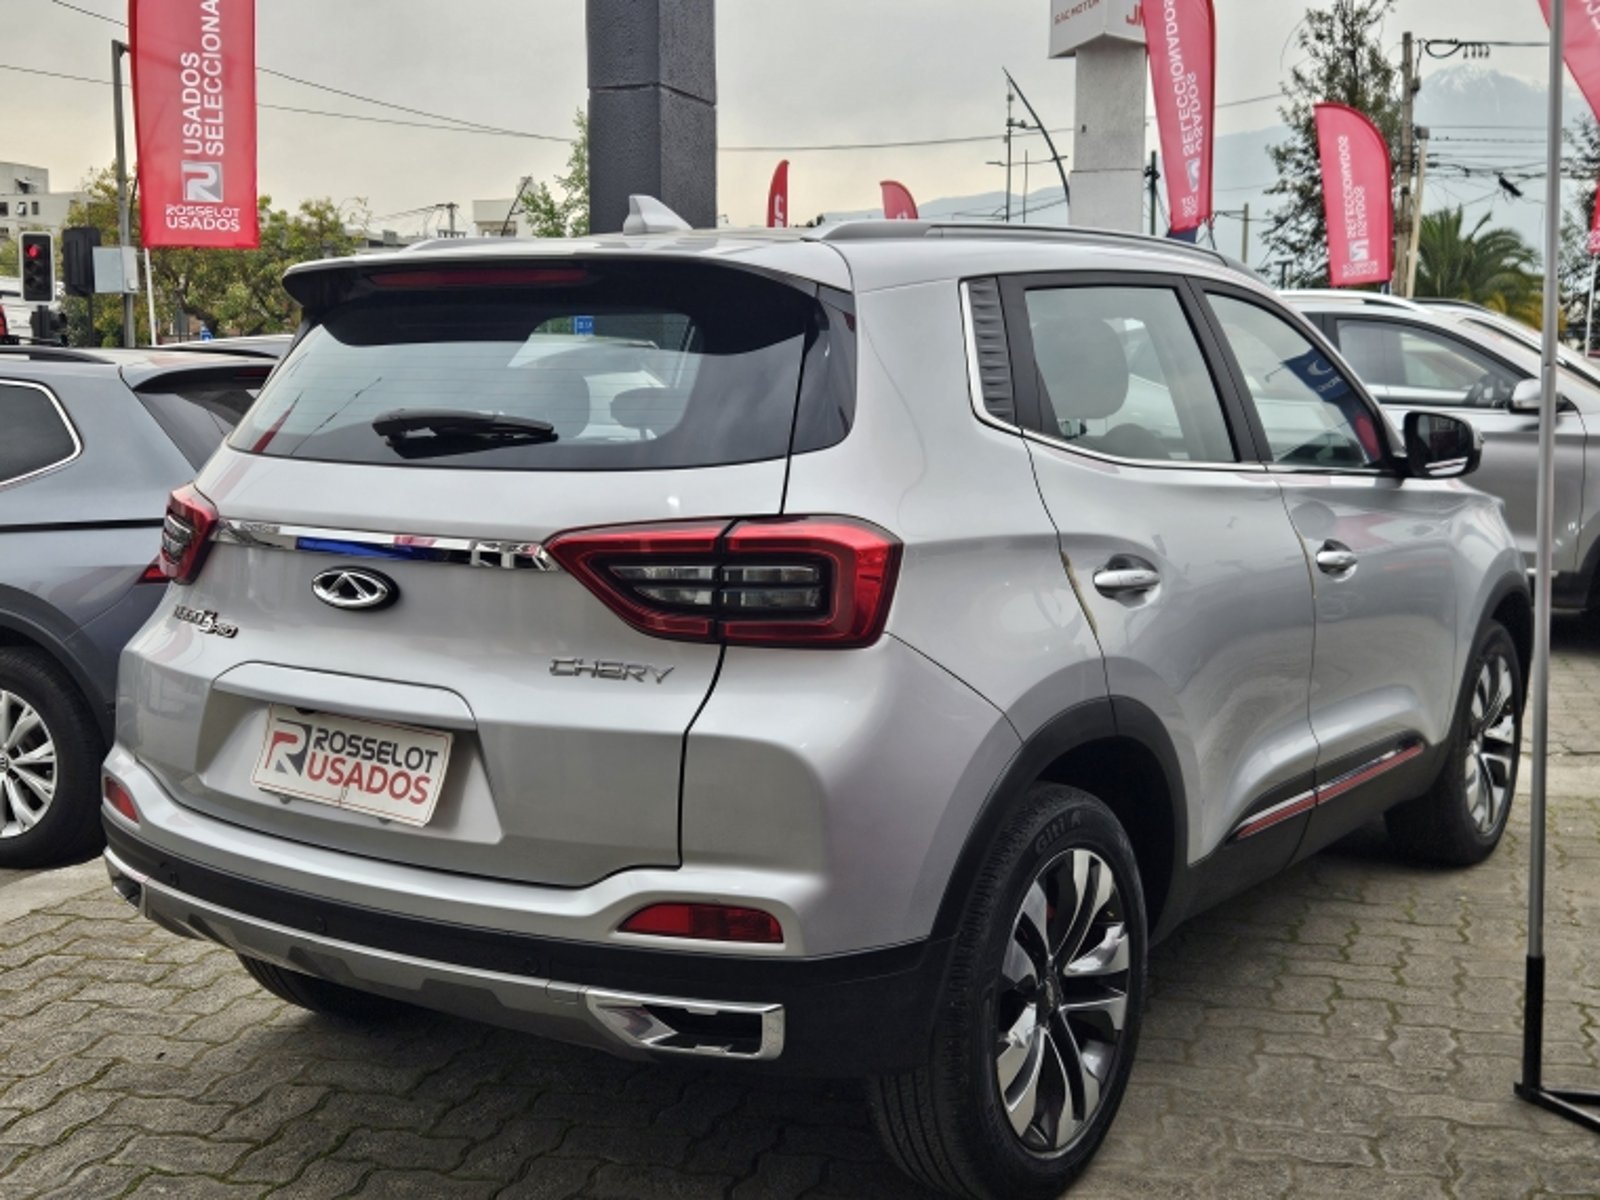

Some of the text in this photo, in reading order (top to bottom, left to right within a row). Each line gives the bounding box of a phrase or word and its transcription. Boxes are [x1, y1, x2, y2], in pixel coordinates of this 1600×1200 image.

[181, 52, 203, 154] USADOS
[166, 204, 240, 217] ROSSELOT
[166, 216, 240, 232] USADOS
[549, 658, 675, 684] CHERY
[313, 728, 438, 773] ROSSELOT
[307, 752, 431, 804] USADOS
